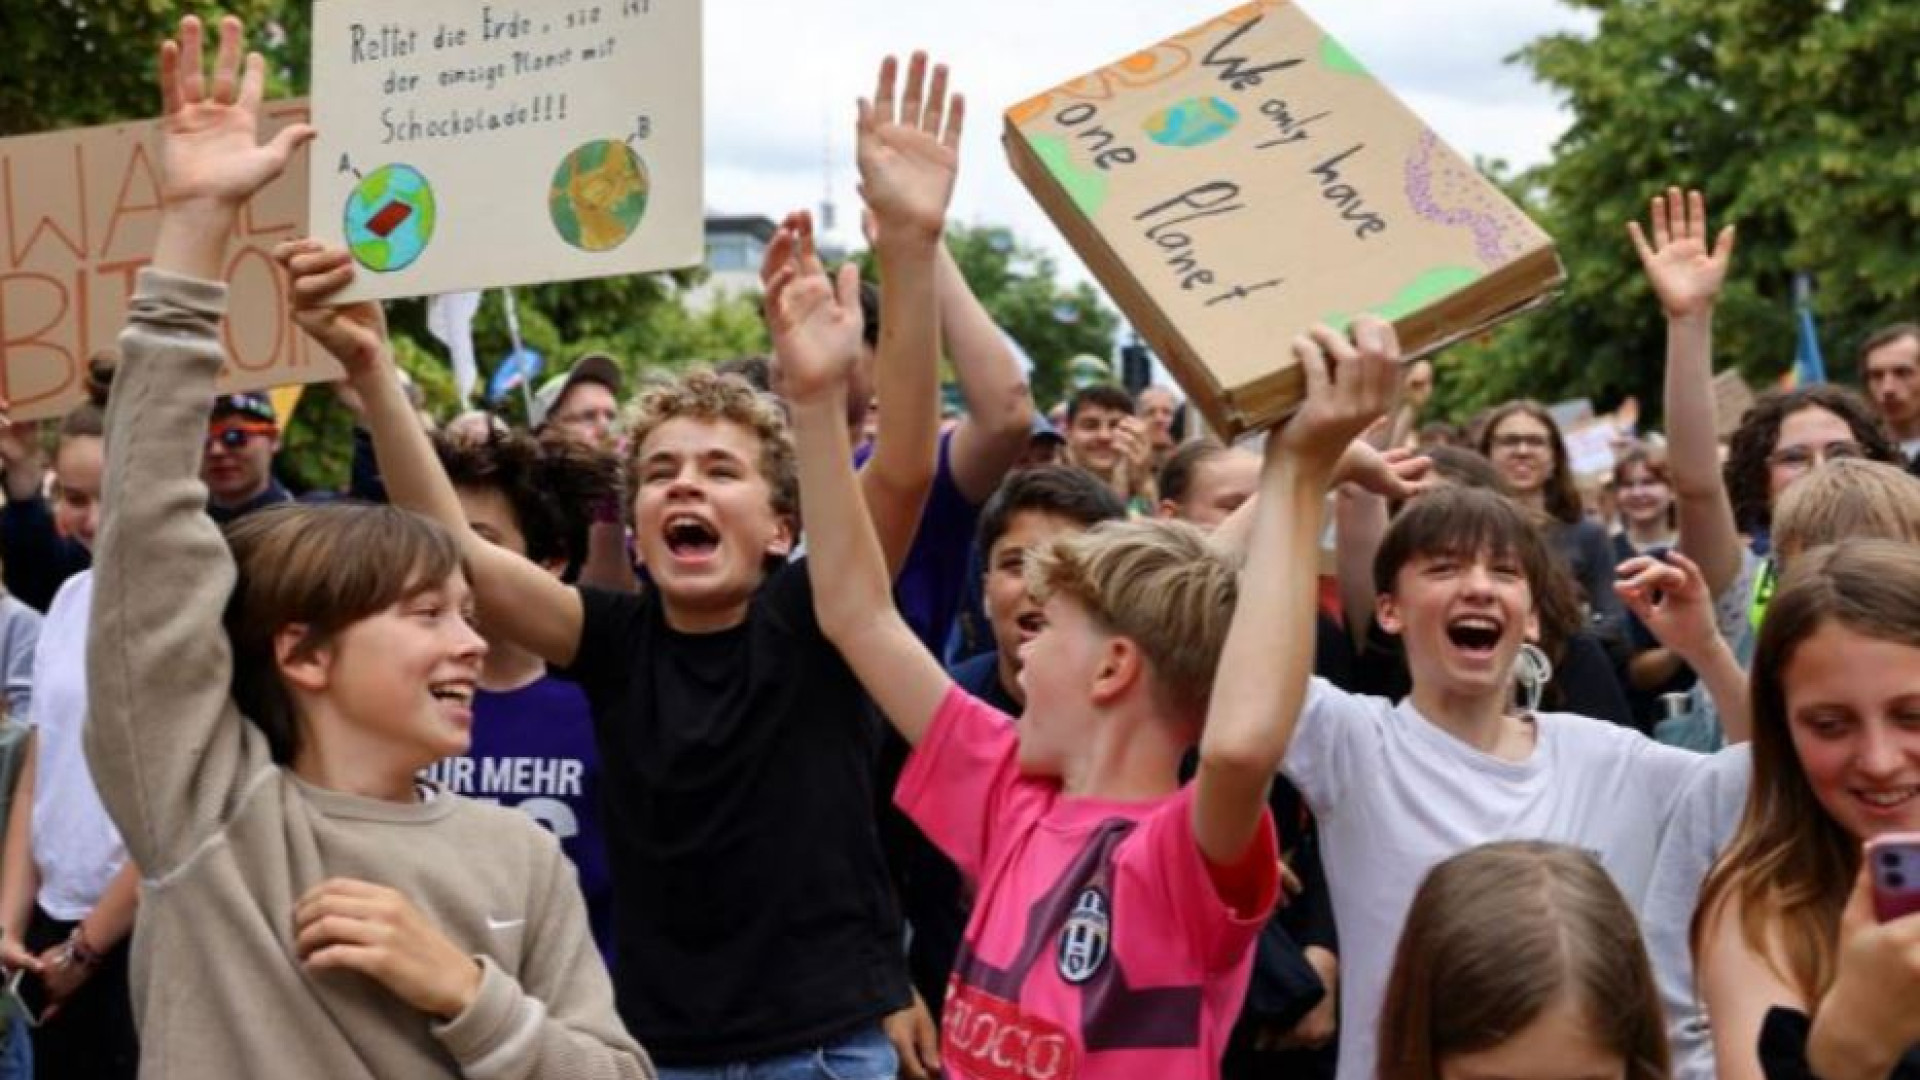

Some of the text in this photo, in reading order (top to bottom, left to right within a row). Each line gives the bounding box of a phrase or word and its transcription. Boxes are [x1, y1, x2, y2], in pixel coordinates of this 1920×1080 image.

[350, 24, 417, 64] Rettet
[433, 24, 466, 50] die
[566, 7, 600, 28] sie
[384, 69, 420, 95] der
[581, 36, 616, 61] mit
[636, 115, 651, 138] B
[1201, 14, 1386, 239] We only have
[338, 152, 352, 174] A
[1055, 102, 1284, 306] one Planet
[480, 756, 584, 796] MEHR
